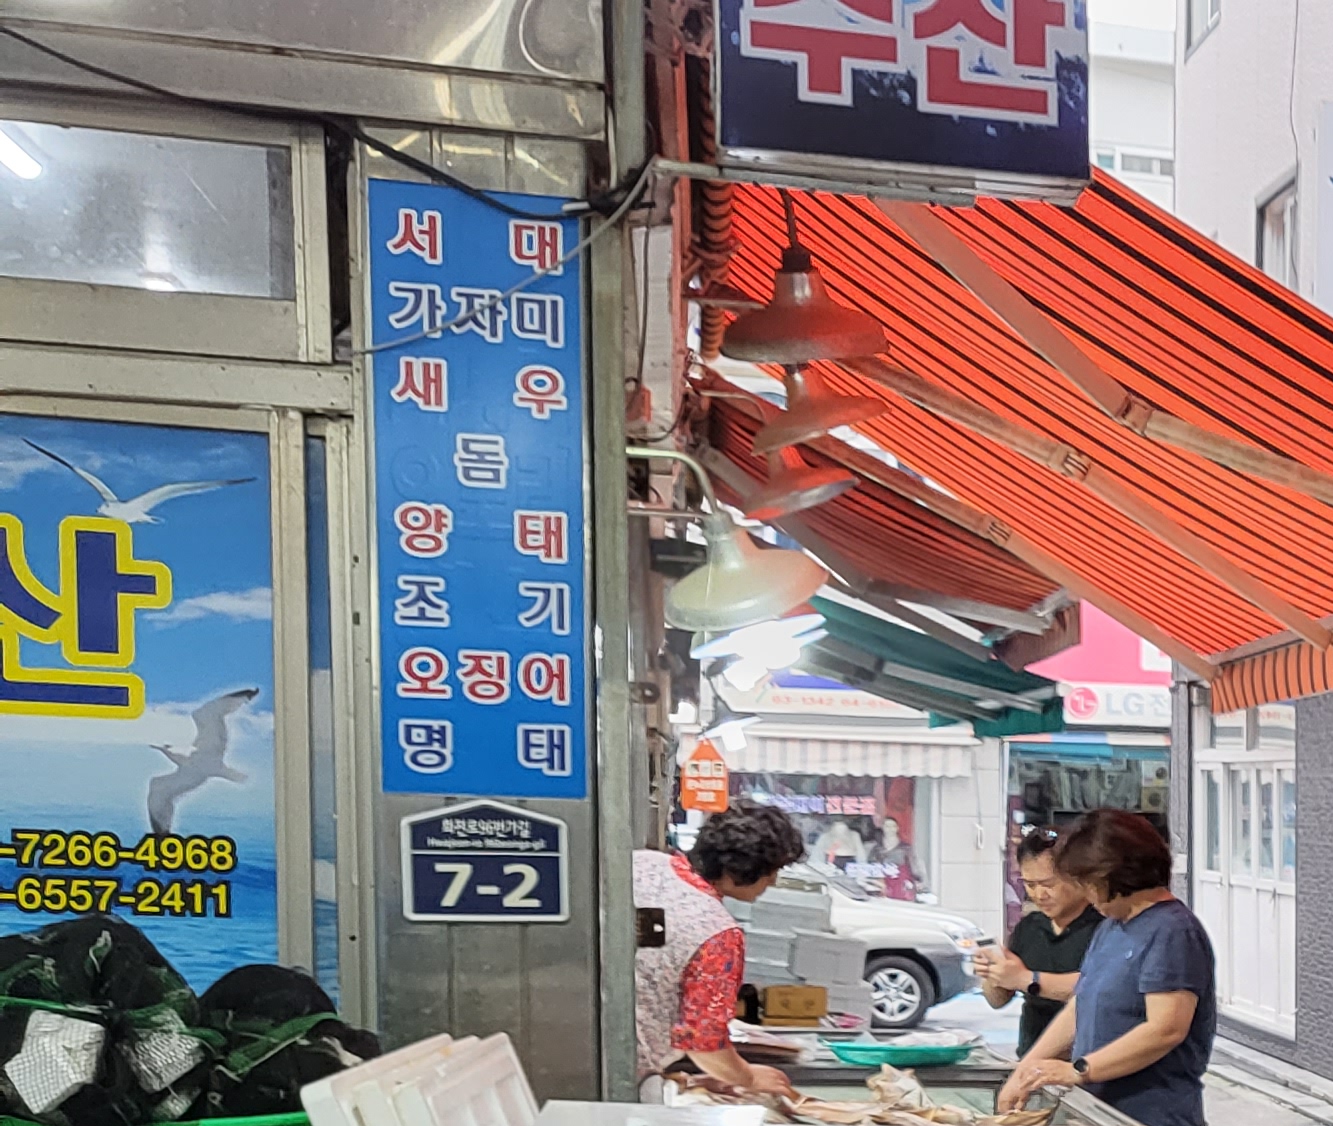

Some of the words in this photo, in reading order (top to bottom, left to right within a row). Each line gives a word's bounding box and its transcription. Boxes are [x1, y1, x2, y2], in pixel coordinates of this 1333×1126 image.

[388, 281, 564, 347] 가자미
[453, 433, 509, 488] 돔
[396, 647, 571, 705] 오징어
[434, 862, 542, 908] 7-2
